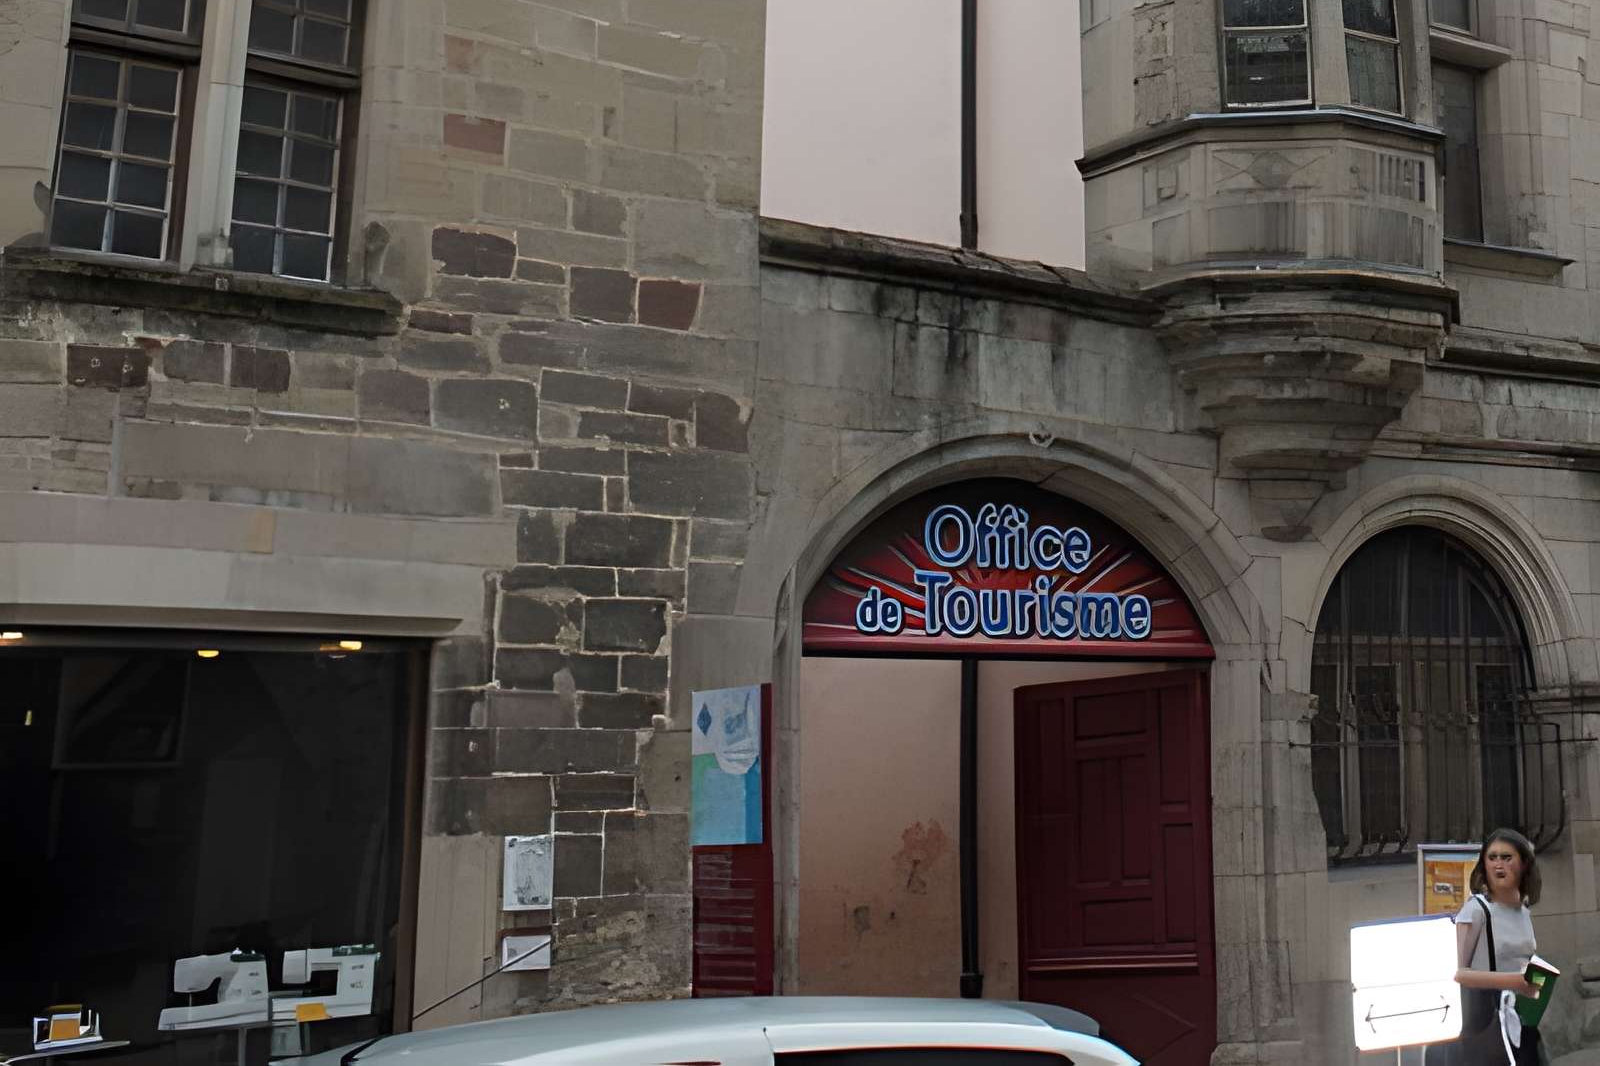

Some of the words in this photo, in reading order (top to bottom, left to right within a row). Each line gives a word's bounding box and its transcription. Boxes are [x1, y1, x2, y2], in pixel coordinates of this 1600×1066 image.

[925, 503, 1091, 574] Office
[855, 586, 905, 634] de
[914, 569, 1153, 640] Tourisme
